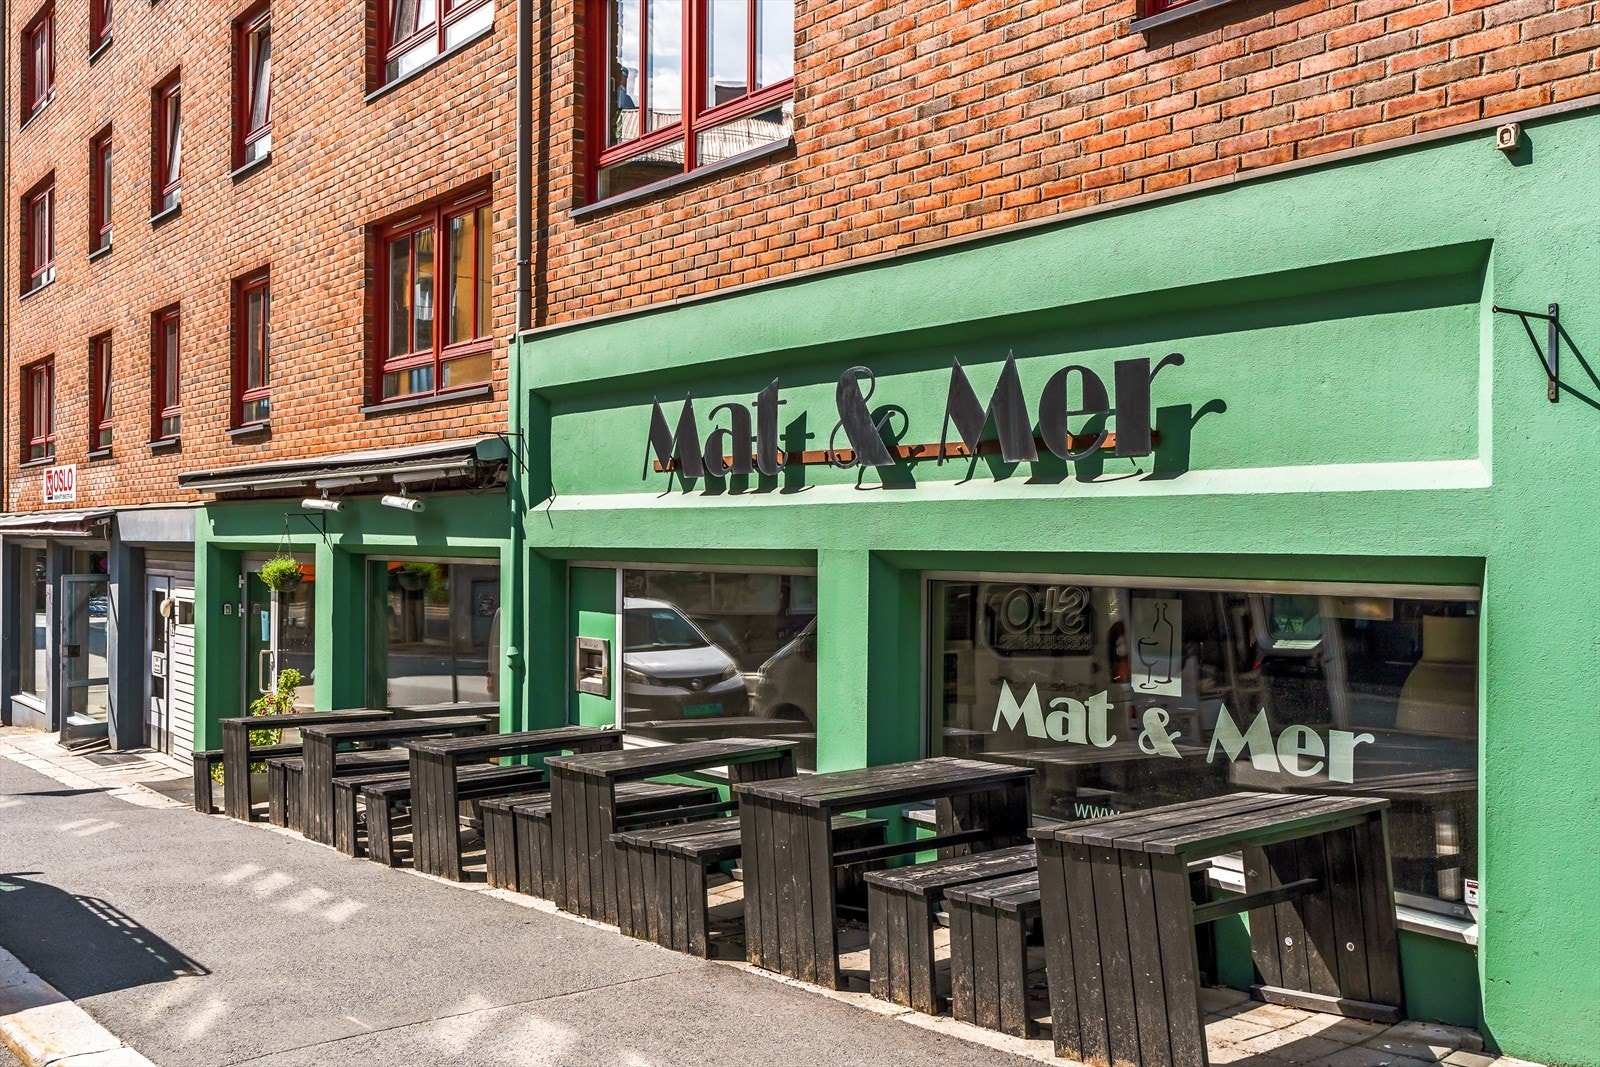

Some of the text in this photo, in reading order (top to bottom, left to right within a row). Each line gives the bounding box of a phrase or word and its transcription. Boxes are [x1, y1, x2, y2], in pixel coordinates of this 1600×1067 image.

[642, 349, 1185, 480] Mat & Mer
[54, 468, 73, 492] OSLO
[992, 679, 1375, 784] Mat & Mer
